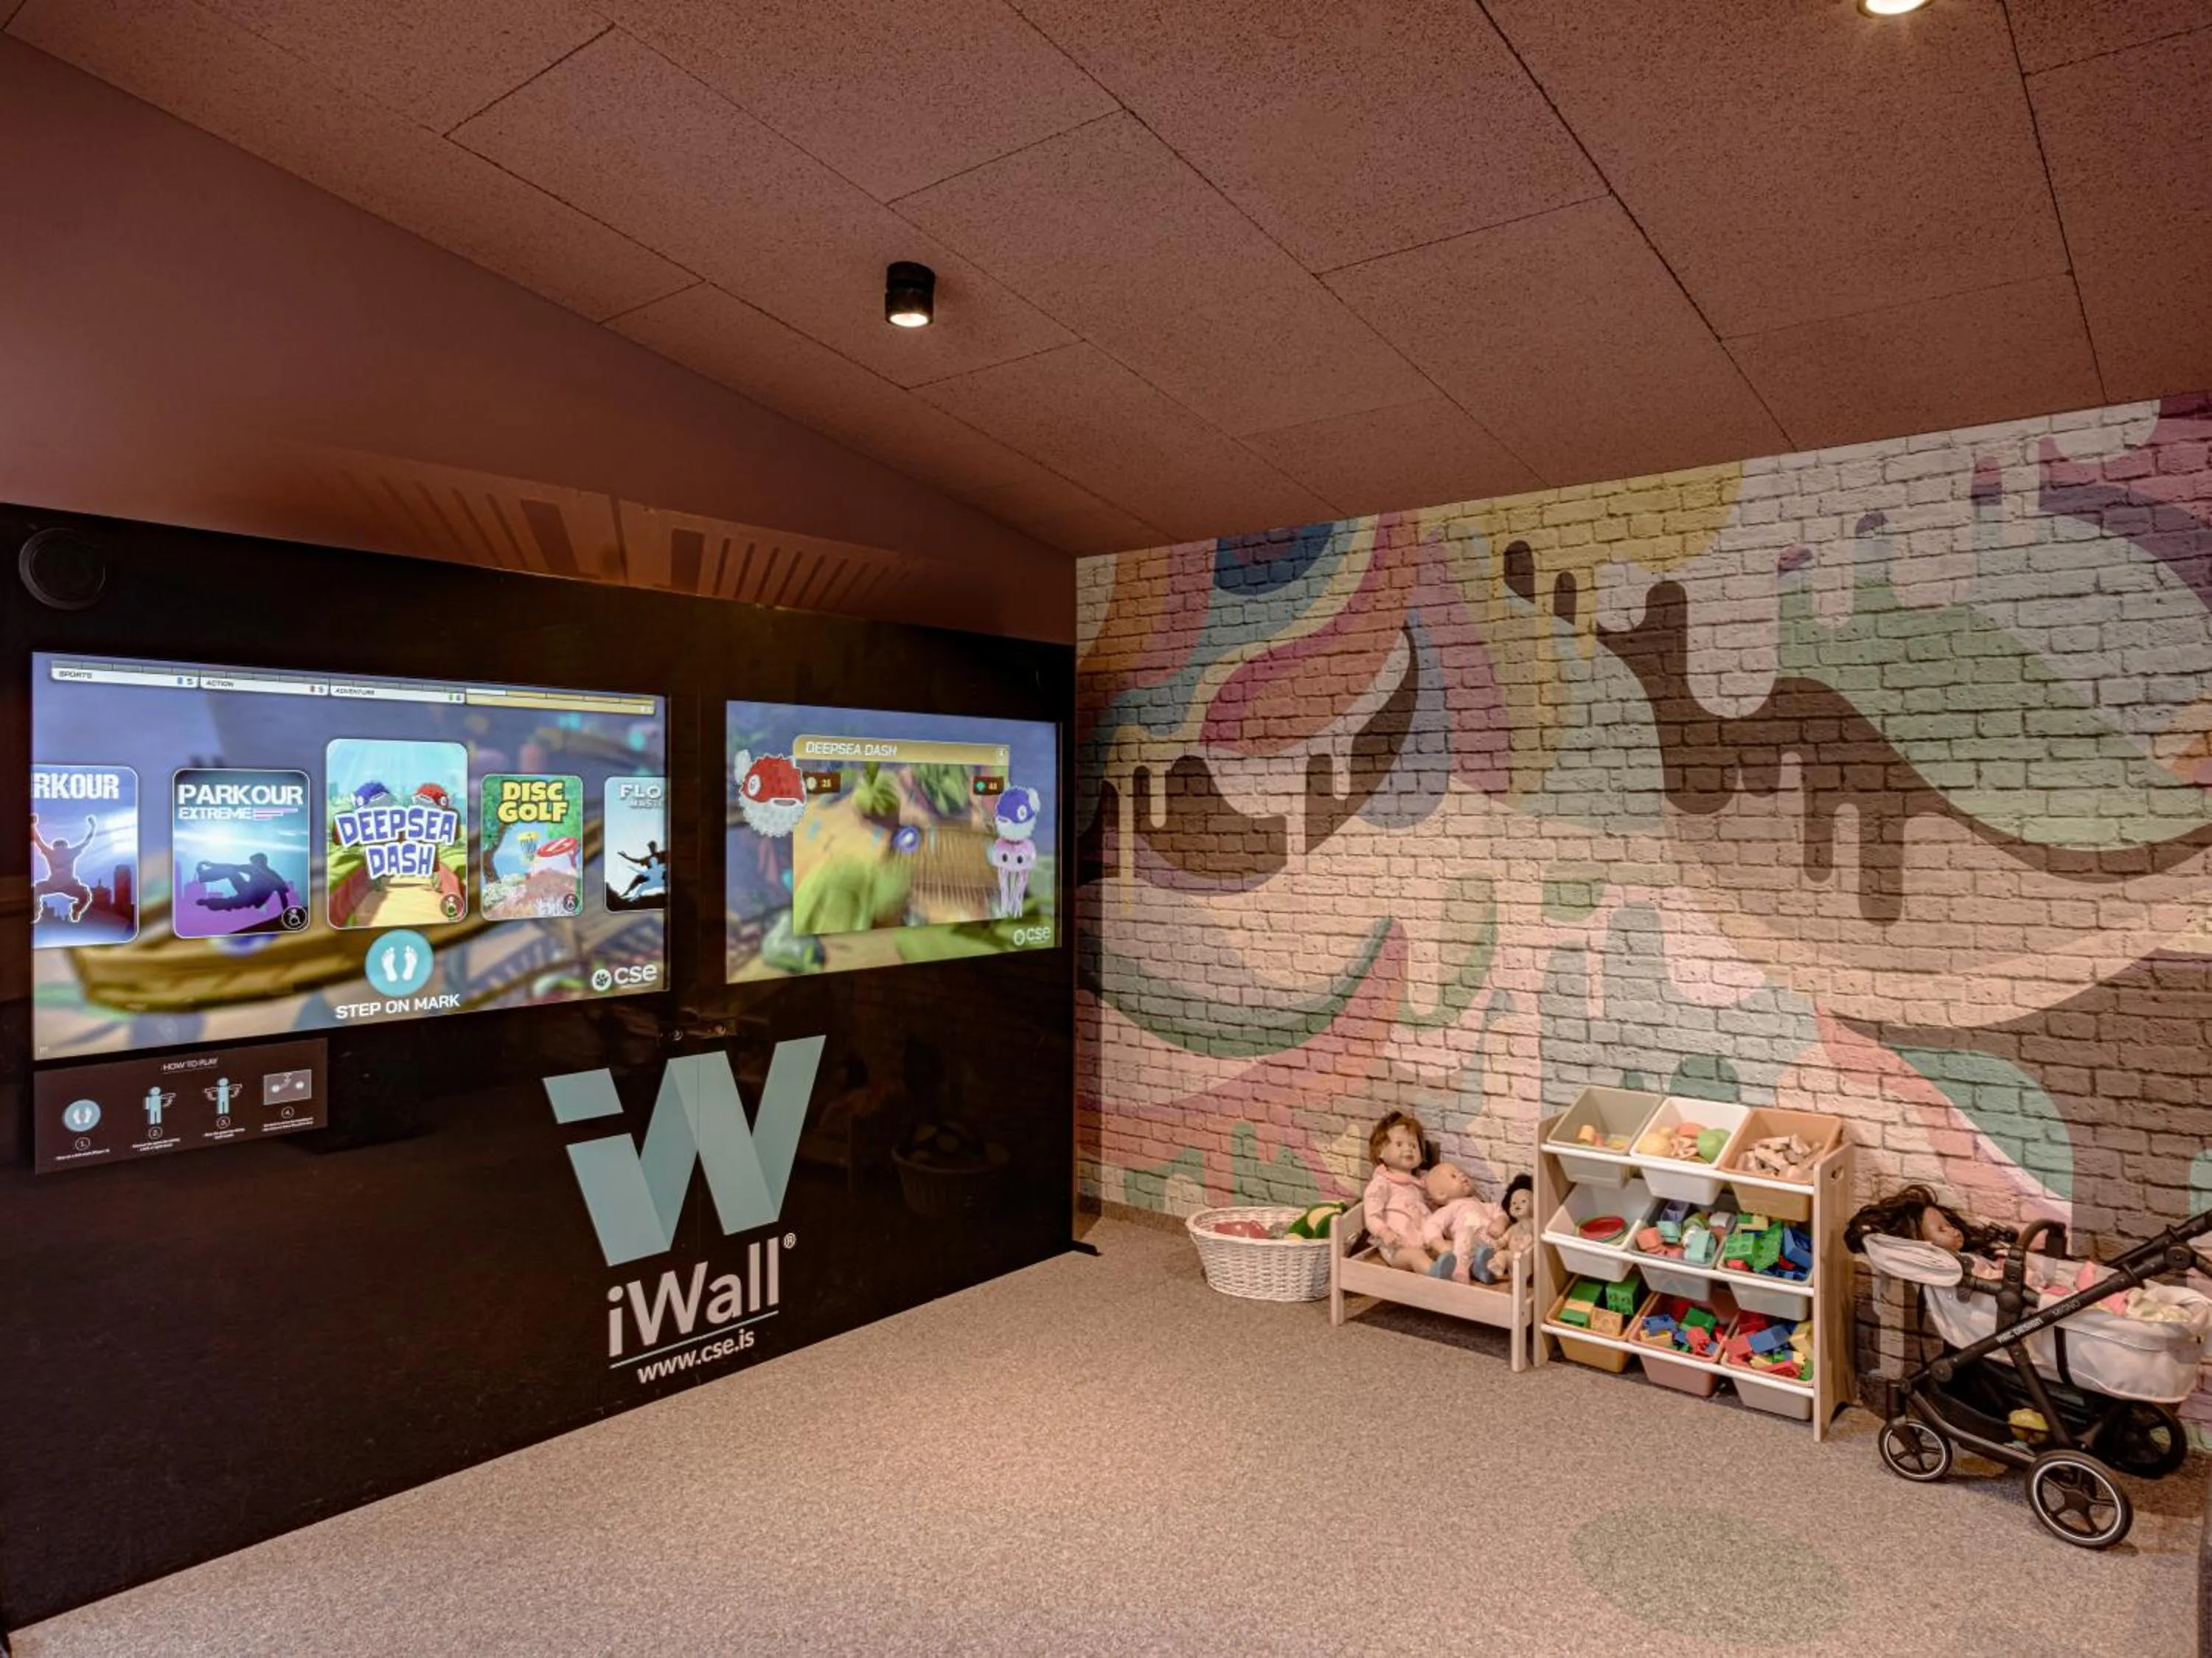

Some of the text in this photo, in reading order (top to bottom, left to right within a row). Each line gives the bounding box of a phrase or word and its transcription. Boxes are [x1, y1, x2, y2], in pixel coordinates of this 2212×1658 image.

[806, 741, 897, 756] DEEPSEA DASH
[178, 784, 303, 806] PARKOUR
[502, 780, 564, 802] DISC
[178, 807, 253, 820] EXTREME
[497, 800, 568, 823] GOLF
[335, 806, 457, 847] DEEPSEA
[366, 841, 436, 878] DASH
[614, 964, 657, 985] cse
[335, 993, 460, 1019] STEP ON MARK
[163, 1062, 185, 1071] HOW
[636, 1328, 755, 1384] www.cse.is
